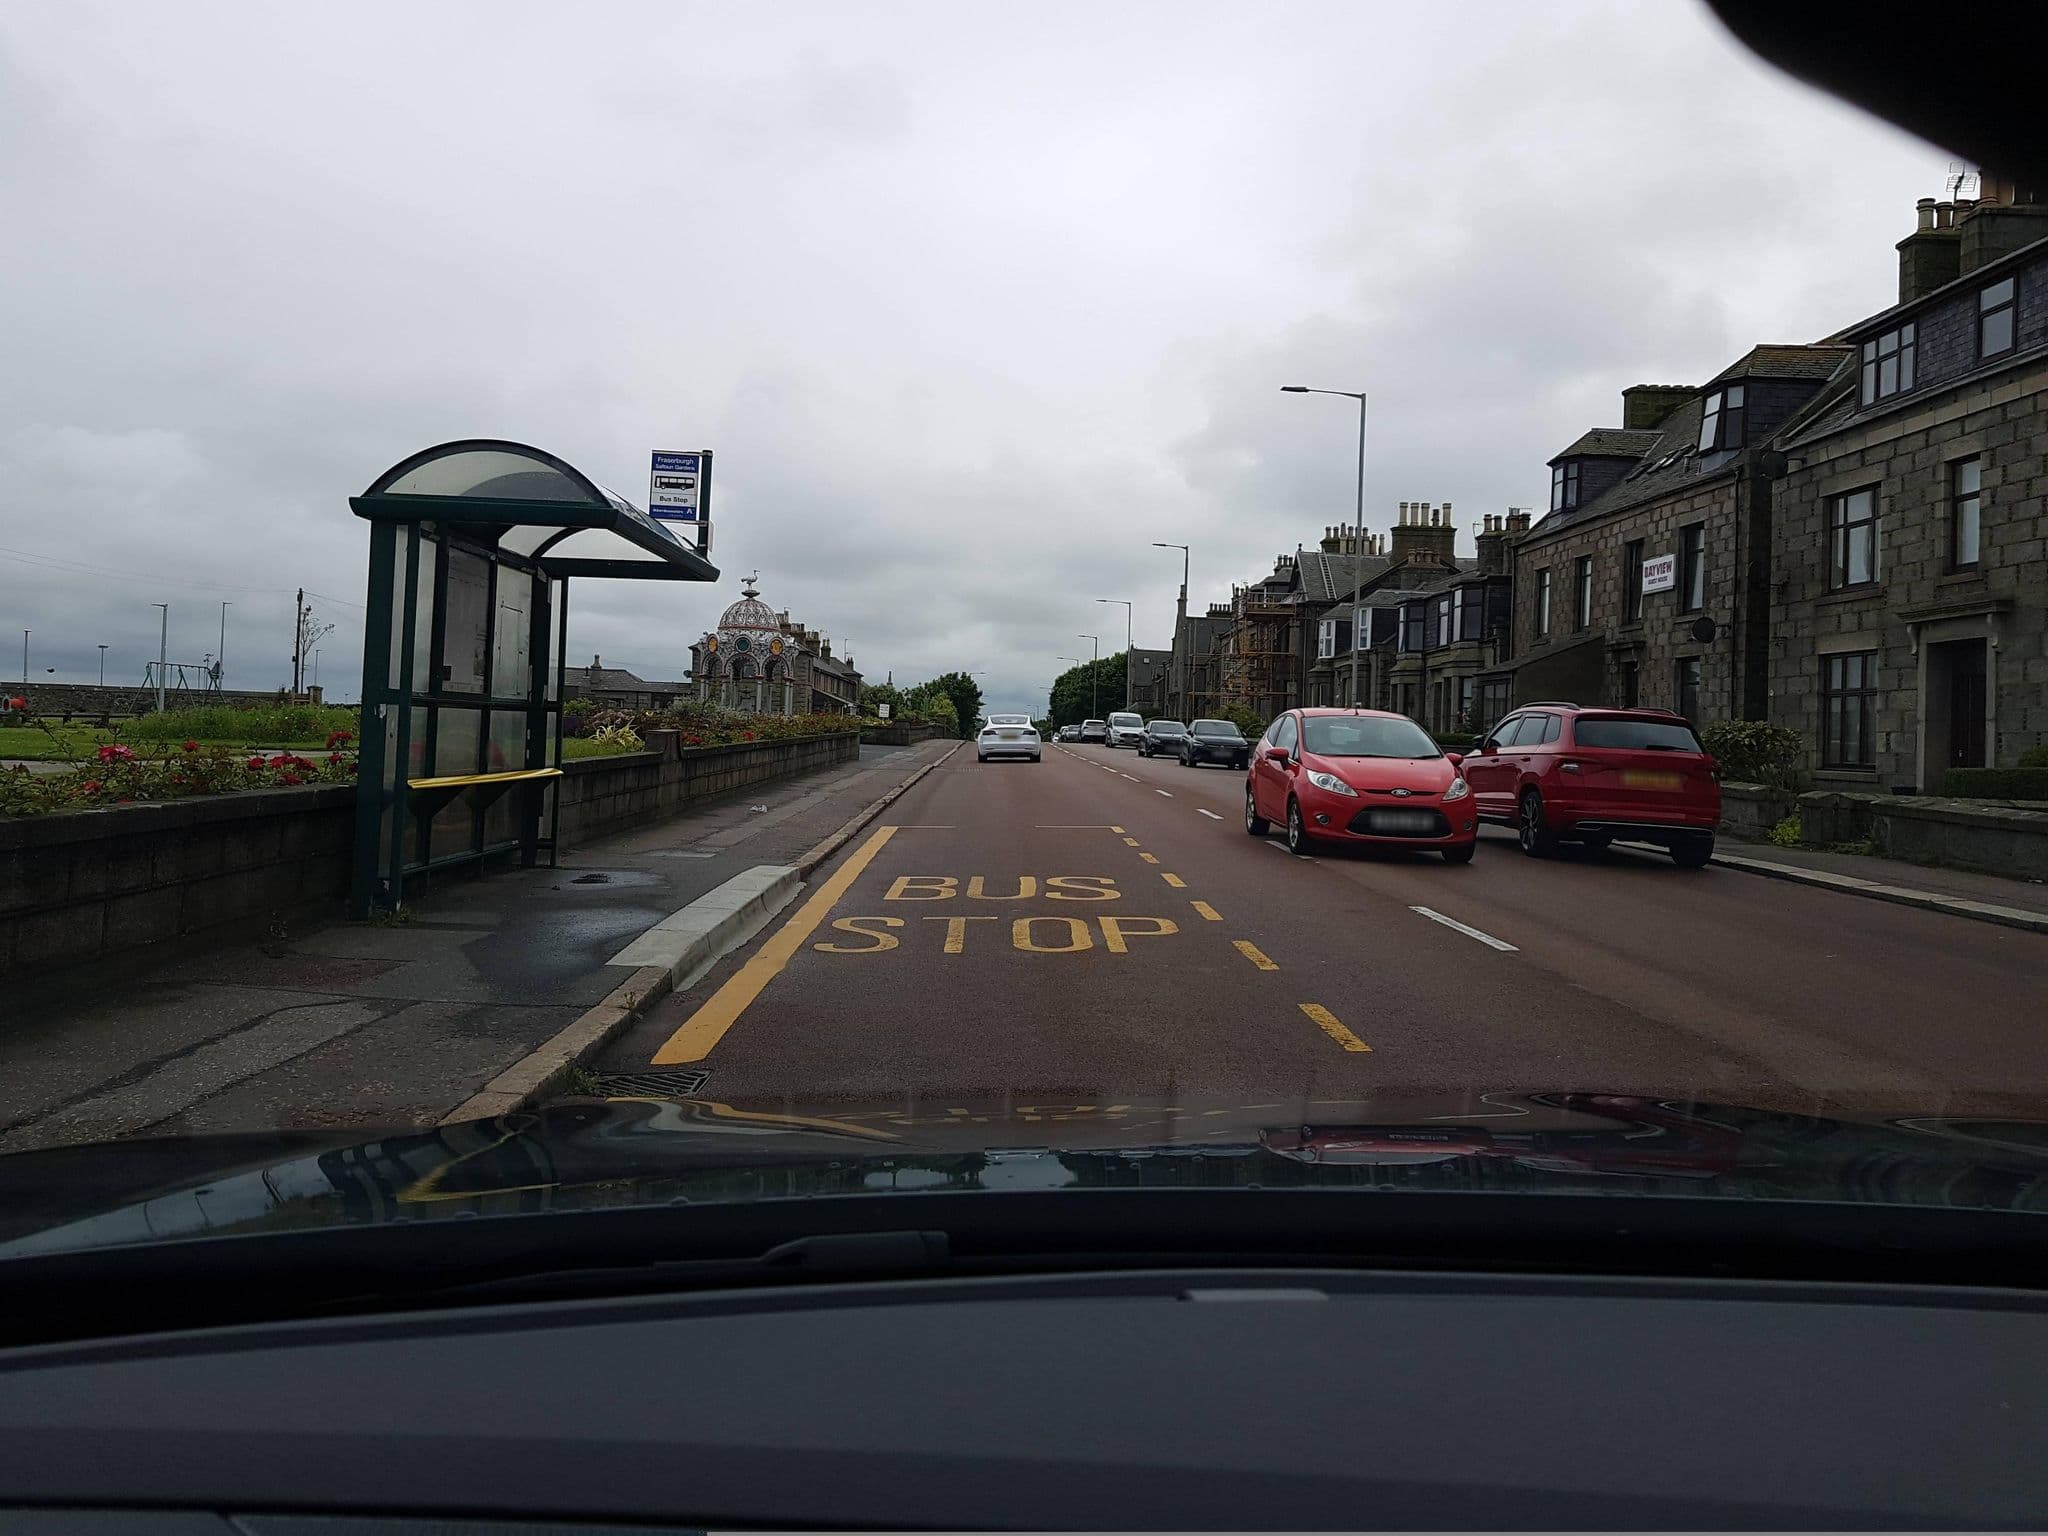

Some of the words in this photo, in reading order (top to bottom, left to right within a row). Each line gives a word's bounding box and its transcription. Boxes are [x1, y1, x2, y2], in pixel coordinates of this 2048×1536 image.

[657, 456, 694, 465] Fraserburgh
[1644, 560, 1673, 578] BAYVIEW
[883, 876, 1122, 901] BUS
[813, 915, 1180, 954] STOP
